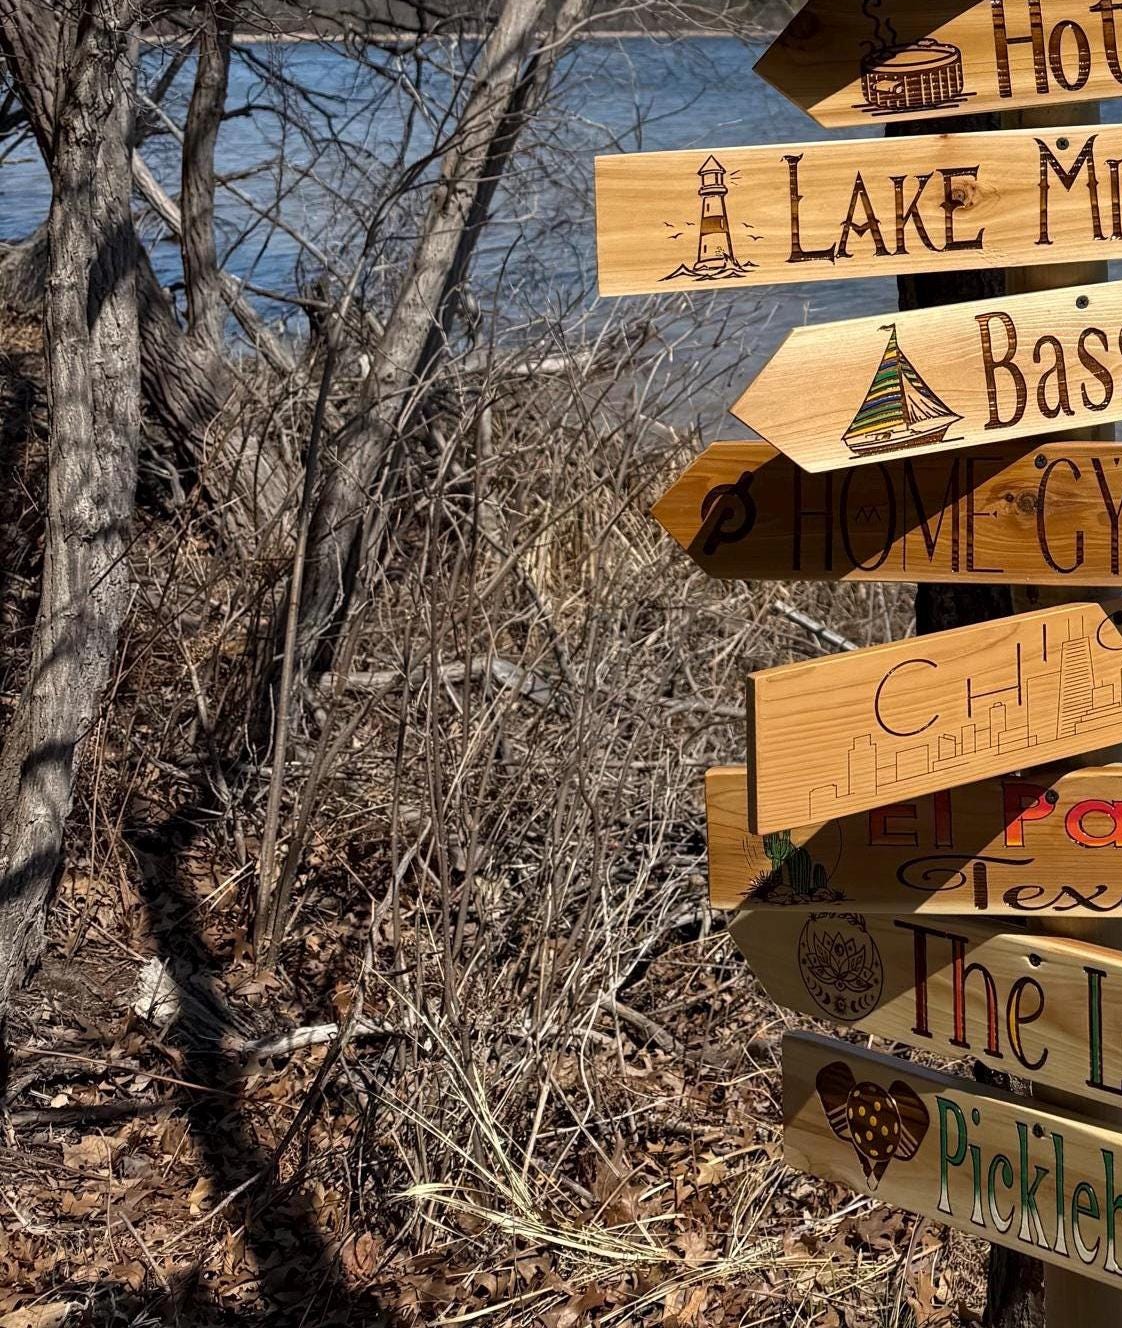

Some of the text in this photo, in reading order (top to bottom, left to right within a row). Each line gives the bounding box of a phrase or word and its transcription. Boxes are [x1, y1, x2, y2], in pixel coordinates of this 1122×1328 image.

[780, 152, 985, 265] LAKE
[792, 456, 1005, 573] HOME
[893, 918, 1049, 1071] The
